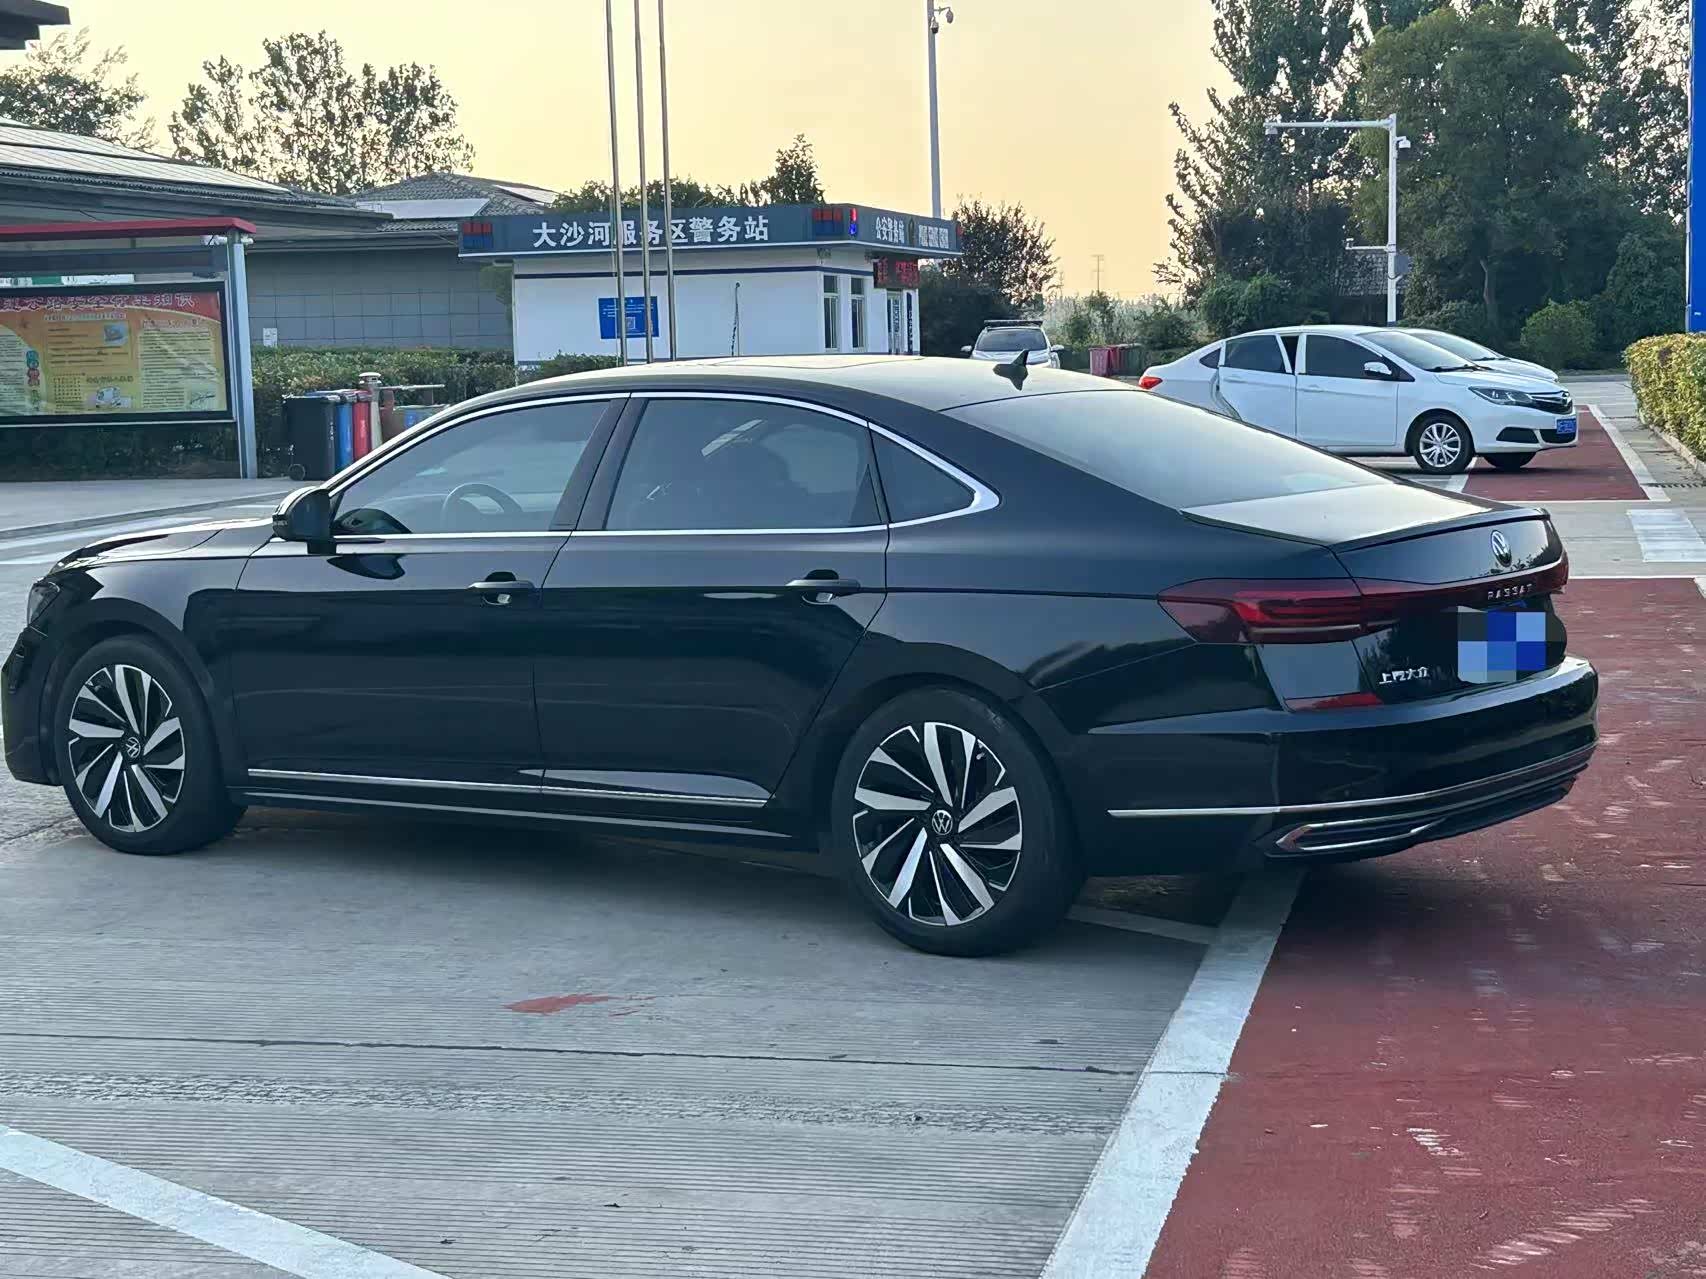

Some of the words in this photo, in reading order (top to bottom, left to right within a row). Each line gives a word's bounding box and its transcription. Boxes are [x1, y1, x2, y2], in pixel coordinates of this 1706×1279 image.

[532, 215, 769, 248] 大沙河服务区警务站
